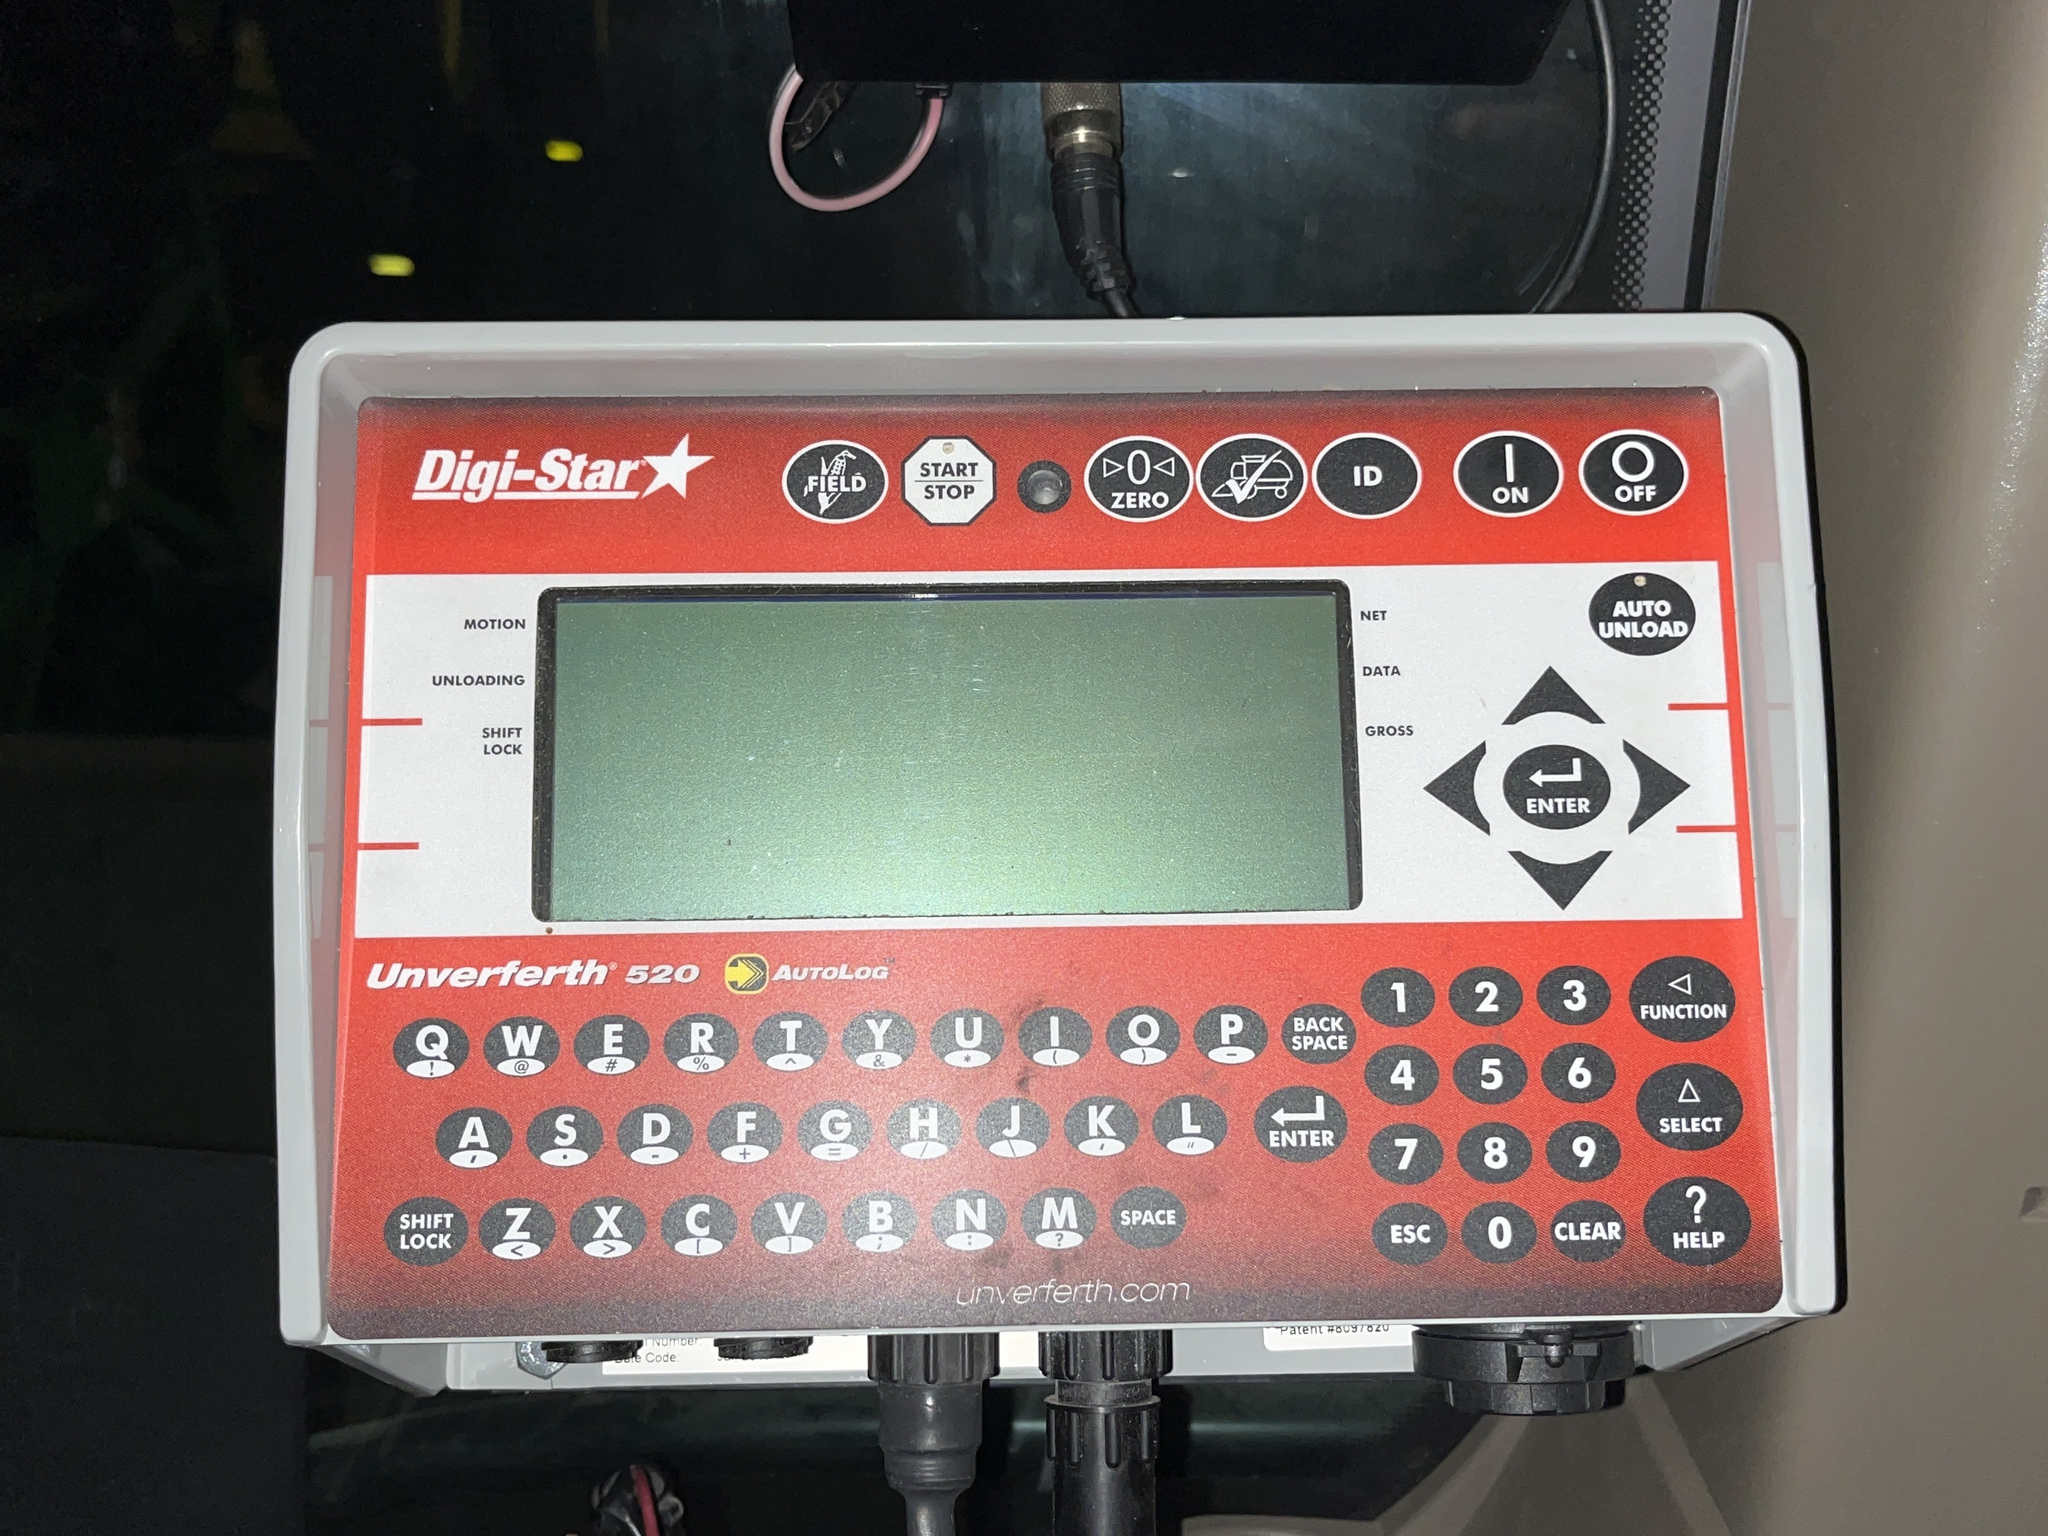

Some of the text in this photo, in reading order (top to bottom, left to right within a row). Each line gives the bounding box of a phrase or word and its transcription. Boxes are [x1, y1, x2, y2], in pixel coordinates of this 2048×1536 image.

[415, 448, 641, 503] Digi-Star
[920, 463, 978, 477] START
[1128, 450, 1151, 484] 0
[1354, 466, 1382, 486] ID
[807, 476, 867, 493] FIELD
[925, 485, 974, 499] STOP
[1493, 487, 1528, 503] ON
[1615, 486, 1656, 502] OFF
[1111, 493, 1170, 510] ZERO
[1361, 611, 1386, 620] NET
[1613, 600, 1671, 617] AUTO
[464, 619, 525, 629] MOTION
[1598, 622, 1689, 639] UNLOAD
[433, 675, 525, 686] UNLOADING
[1363, 666, 1400, 676] DATA
[483, 728, 522, 738] SHIFT
[1366, 726, 1413, 736] GROSS
[484, 744, 522, 755] LOCK
[1527, 798, 1590, 813] ENTER
[626, 965, 699, 983] 520
[1391, 983, 1405, 1012] 1
[1476, 982, 1498, 1011] 2
[1563, 980, 1586, 1011] 3
[1294, 1017, 1343, 1031] BACK
[1641, 1004, 1726, 1019] FUNCTION
[416, 1025, 448, 1059] Q
[502, 1026, 542, 1055] W
[604, 1024, 623, 1054] E
[691, 1023, 714, 1053] R
[780, 1021, 802, 1051] T
[866, 1019, 892, 1050] Y
[956, 1017, 982, 1048] U
[1050, 1016, 1059, 1046] I
[1128, 1014, 1159, 1046] O
[1221, 1014, 1243, 1044] P
[1292, 1035, 1347, 1050] SPACE
[1391, 1060, 1415, 1090] 4
[1481, 1059, 1502, 1089] 5
[1568, 1058, 1591, 1088] 6
[459, 1117, 489, 1148] A
[554, 1114, 576, 1146] S
[643, 1113, 670, 1144] D
[737, 1112, 756, 1142] F
[820, 1109, 851, 1139] G
[909, 1108, 938, 1139] H
[1002, 1106, 1020, 1137] J
[1089, 1105, 1116, 1136] K
[1182, 1103, 1201, 1133] L
[1660, 1118, 1722, 1133] SELECT
[1270, 1130, 1334, 1147] ENTER
[1484, 1137, 1507, 1169] 8
[1573, 1136, 1596, 1167] 9
[1395, 1139, 1418, 1169] 7
[775, 1202, 805, 1234] V
[868, 1202, 893, 1231] B
[956, 1199, 986, 1231] N
[1042, 1197, 1077, 1229] M
[1121, 1210, 1175, 1225] SPACE
[1686, 1186, 1706, 1223] ?
[400, 1214, 453, 1229] SHIFT
[503, 1208, 531, 1239] Z
[593, 1206, 623, 1238] X
[686, 1204, 709, 1236] C
[1391, 1225, 1430, 1243] ESC
[1488, 1217, 1511, 1249] 0
[1555, 1222, 1621, 1241] CLEAR
[401, 1234, 451, 1249] LOCK
[1056, 1233, 1063, 1246] ?
[1674, 1232, 1724, 1248] HELP
[956, 1279, 1190, 1305] unverferth.com
[1281, 1326, 1323, 1335] Patent
